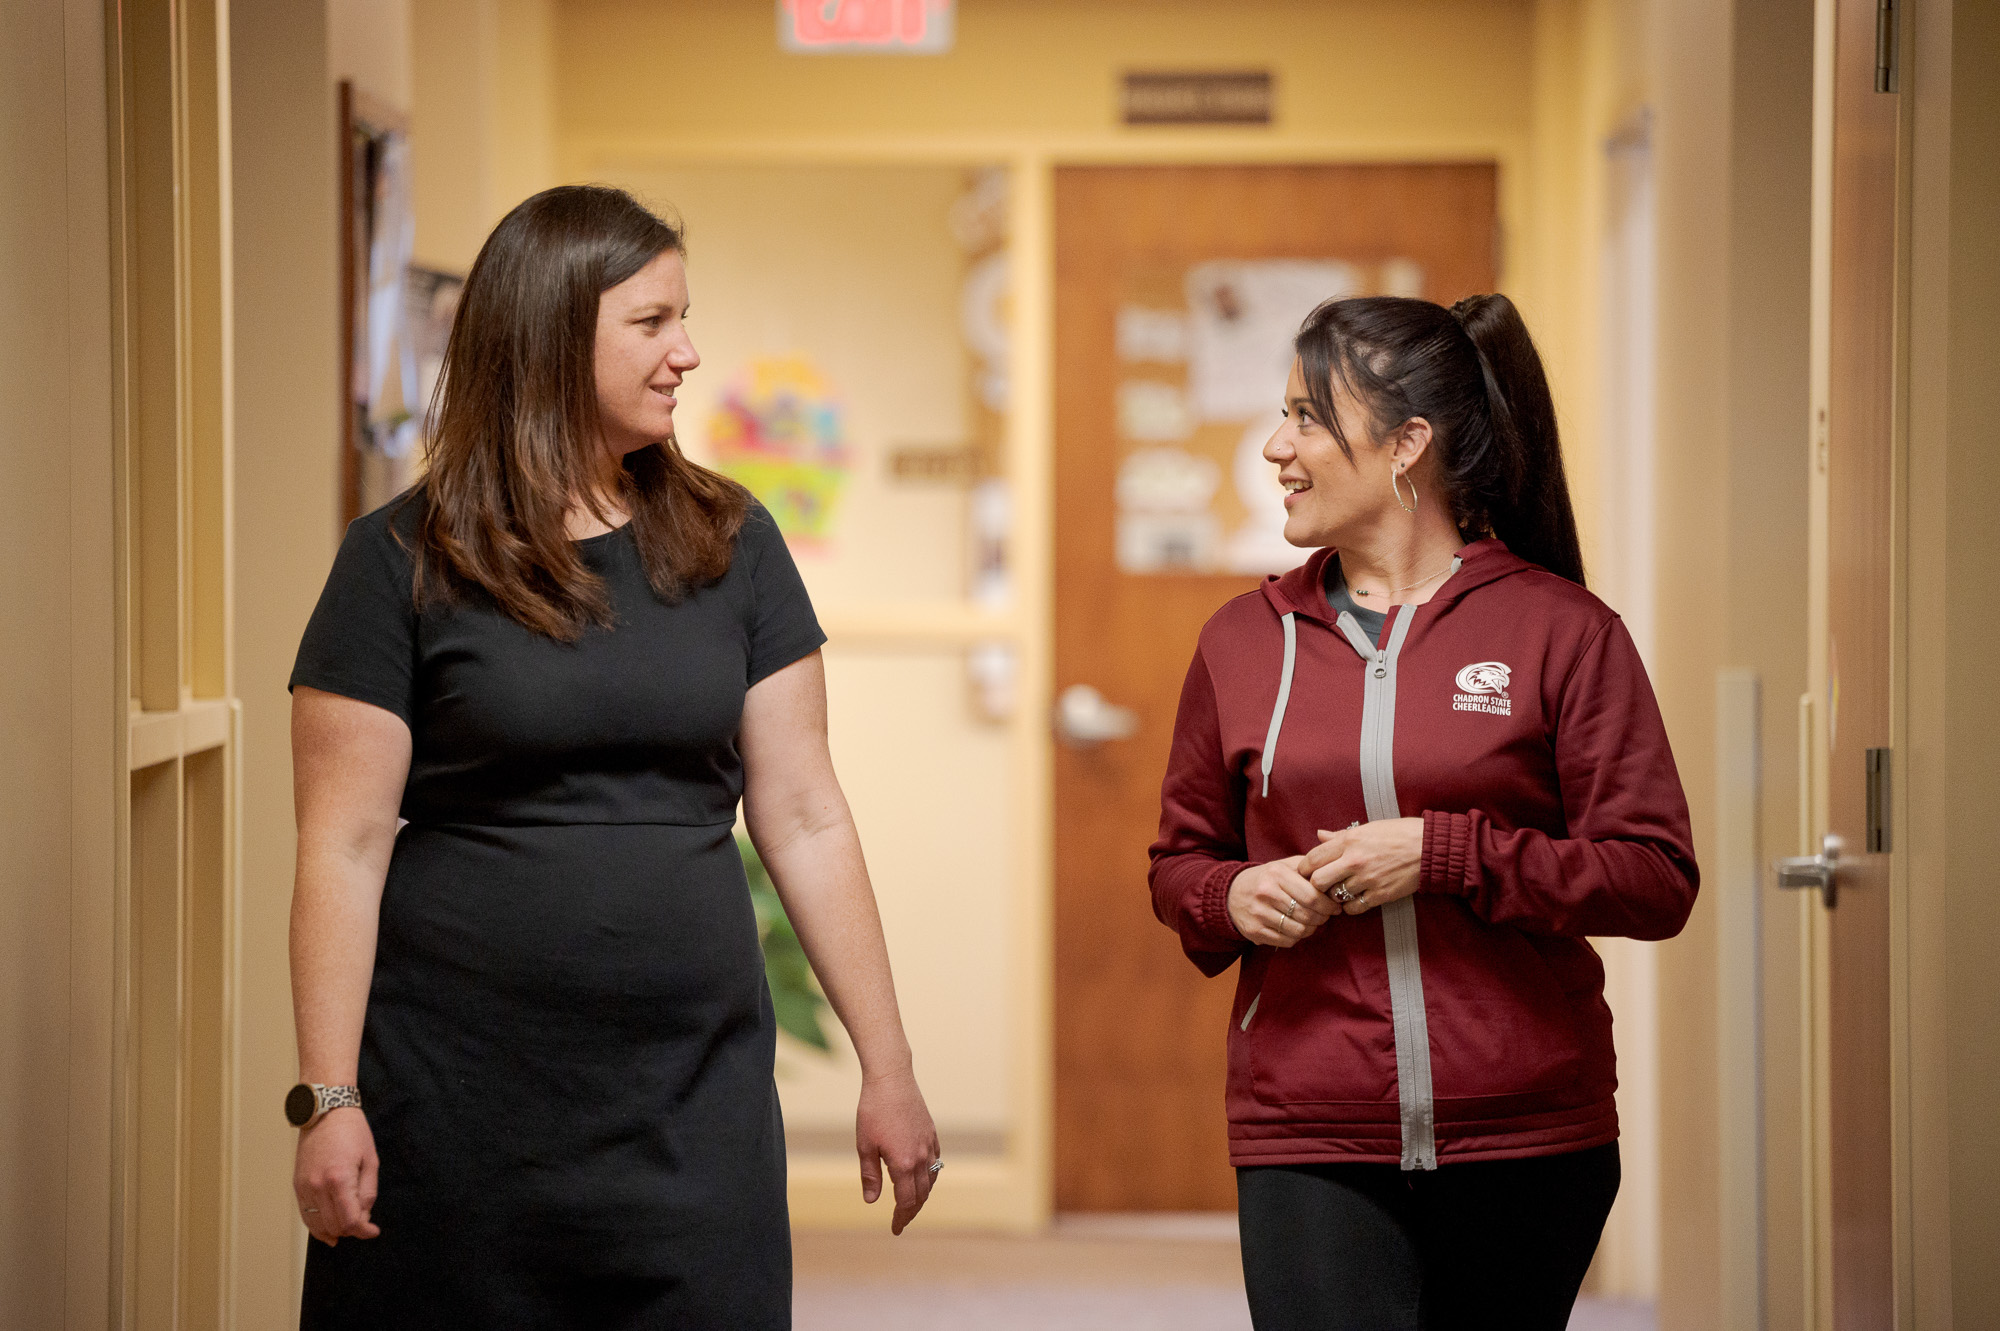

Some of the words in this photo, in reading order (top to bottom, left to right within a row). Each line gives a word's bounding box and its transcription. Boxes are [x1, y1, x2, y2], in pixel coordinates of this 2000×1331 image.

[1453, 694, 1489, 703] CHADRON
[1490, 697, 1511, 707] STATE
[1453, 702, 1511, 716] CHEERLEADING
